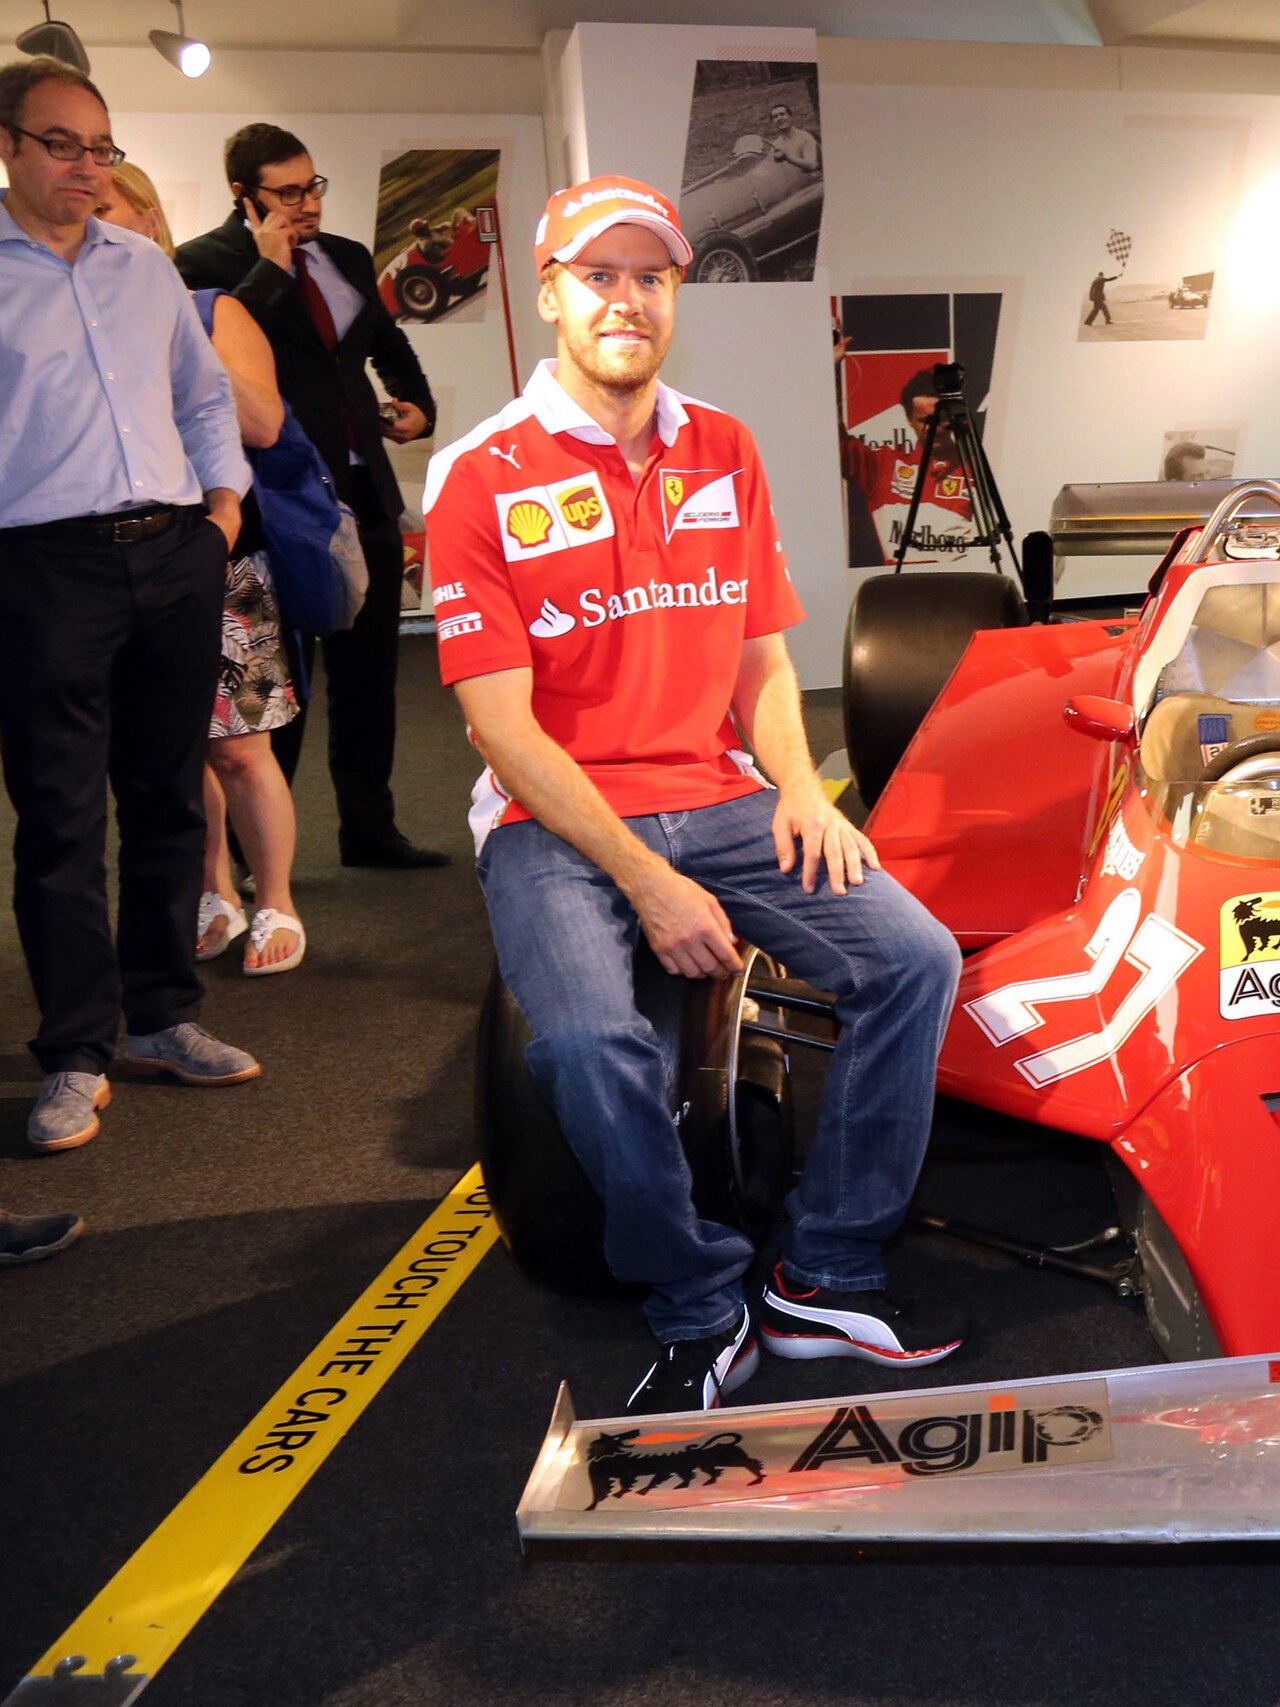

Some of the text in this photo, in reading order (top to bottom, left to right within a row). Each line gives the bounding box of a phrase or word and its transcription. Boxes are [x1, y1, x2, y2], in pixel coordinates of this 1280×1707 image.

[563, 496, 601, 527] ups
[889, 520, 967, 554] Mrlboro
[579, 566, 748, 628] Santander
[962, 887, 1206, 1090] 27
[237, 1185, 492, 1475] OT TOUCH THE CARS
[788, 1394, 1103, 1476] Agip
